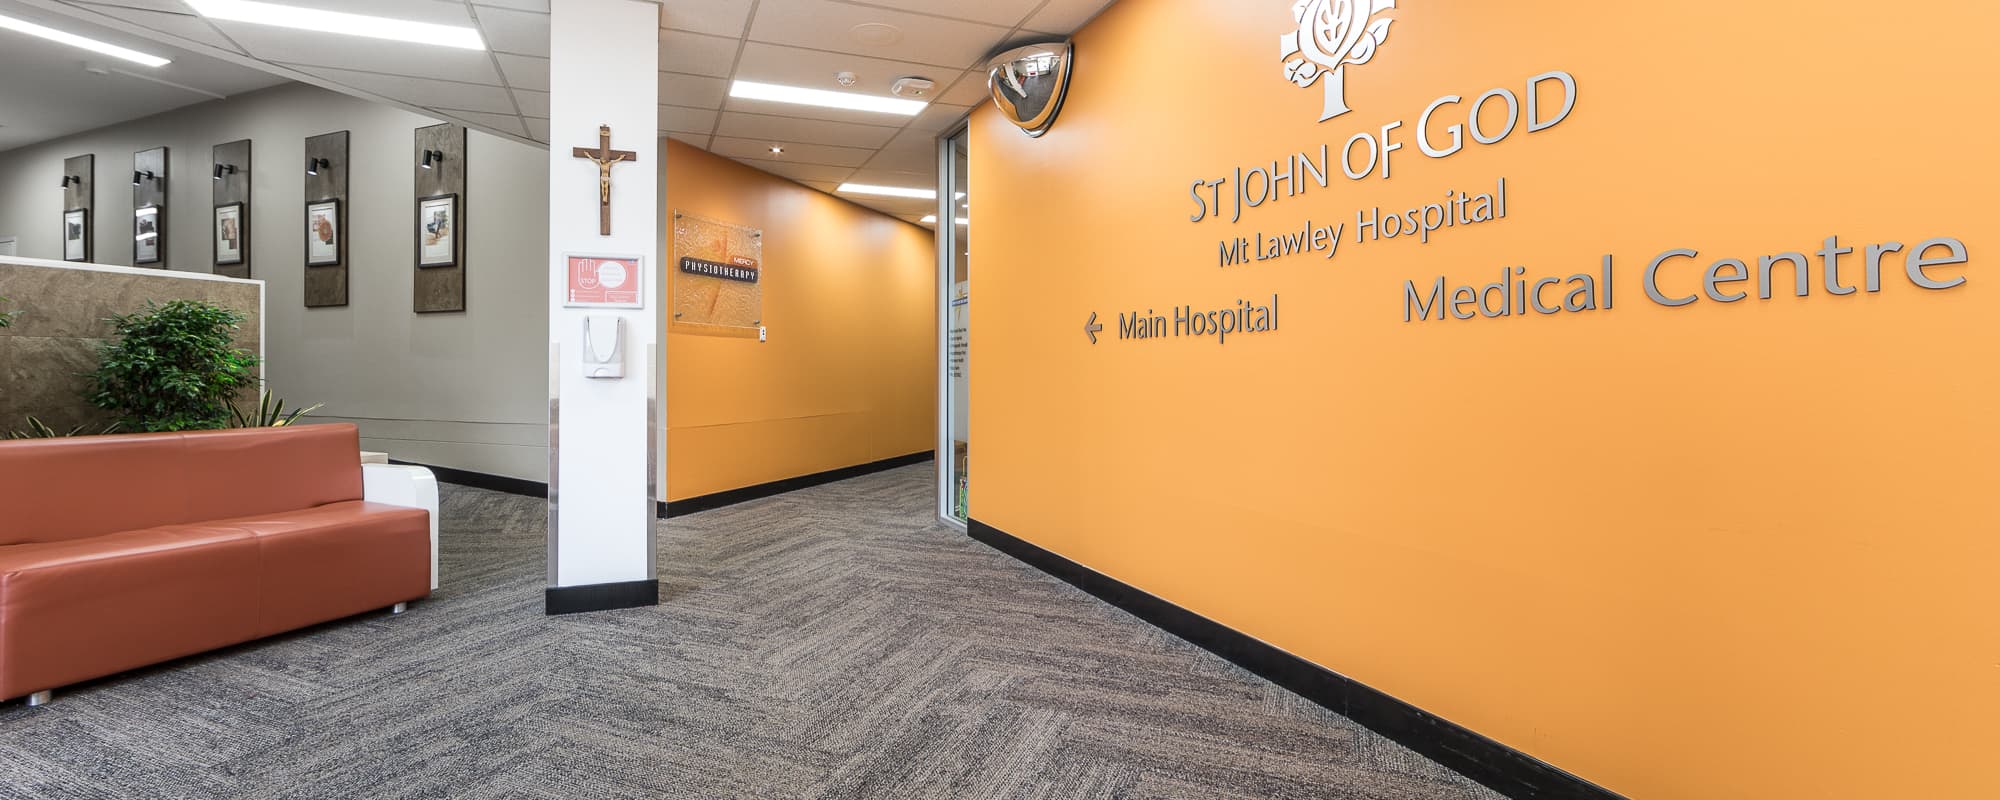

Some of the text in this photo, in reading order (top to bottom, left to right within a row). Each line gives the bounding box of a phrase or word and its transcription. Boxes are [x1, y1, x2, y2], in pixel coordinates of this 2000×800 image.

[1189, 70, 1577, 223] ST JOHN OF GOD
[1218, 177, 1506, 267] Mt Lawley Hospital
[685, 260, 755, 280] PHYSIOTHERAPY
[733, 257, 755, 266] MERCY
[1403, 235, 1969, 323] Medical Centre
[1118, 293, 1278, 345] Main Hospital
